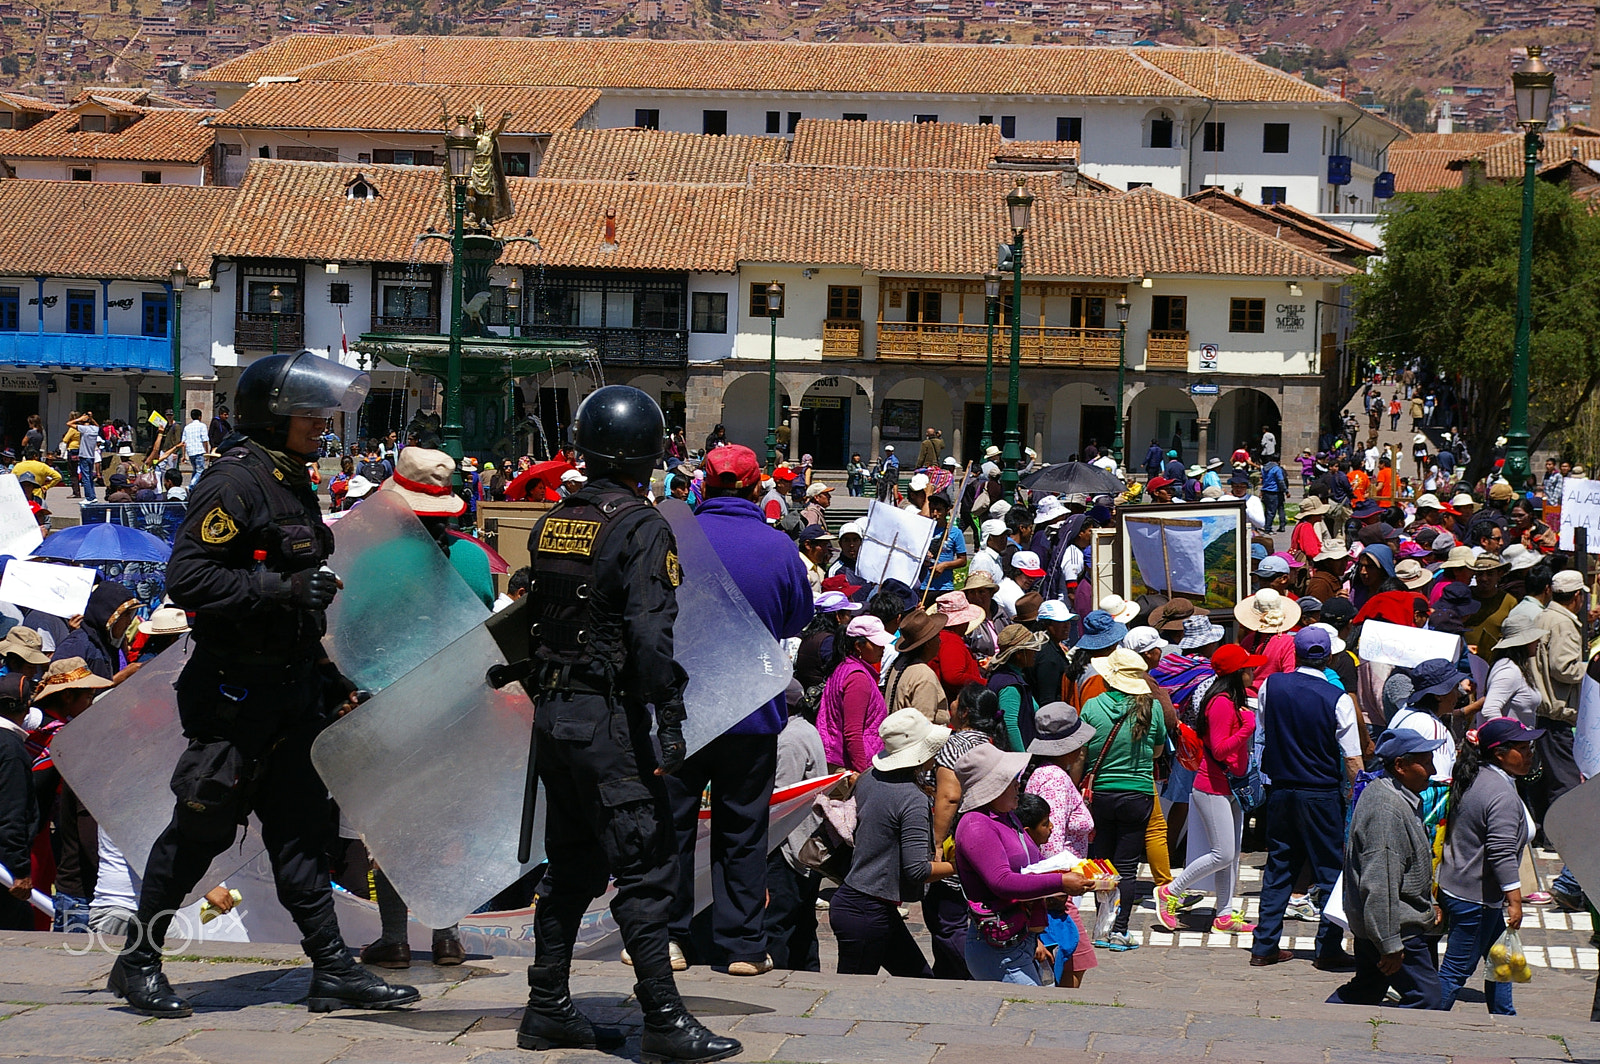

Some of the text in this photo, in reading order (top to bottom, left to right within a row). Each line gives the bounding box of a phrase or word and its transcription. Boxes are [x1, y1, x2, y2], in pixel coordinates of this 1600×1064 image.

[28, 296, 58, 308] BEBOS
[1276, 303, 1306, 313] CALLE
[545, 521, 594, 540] POLICIA
[541, 536, 590, 553] NACIONAL
